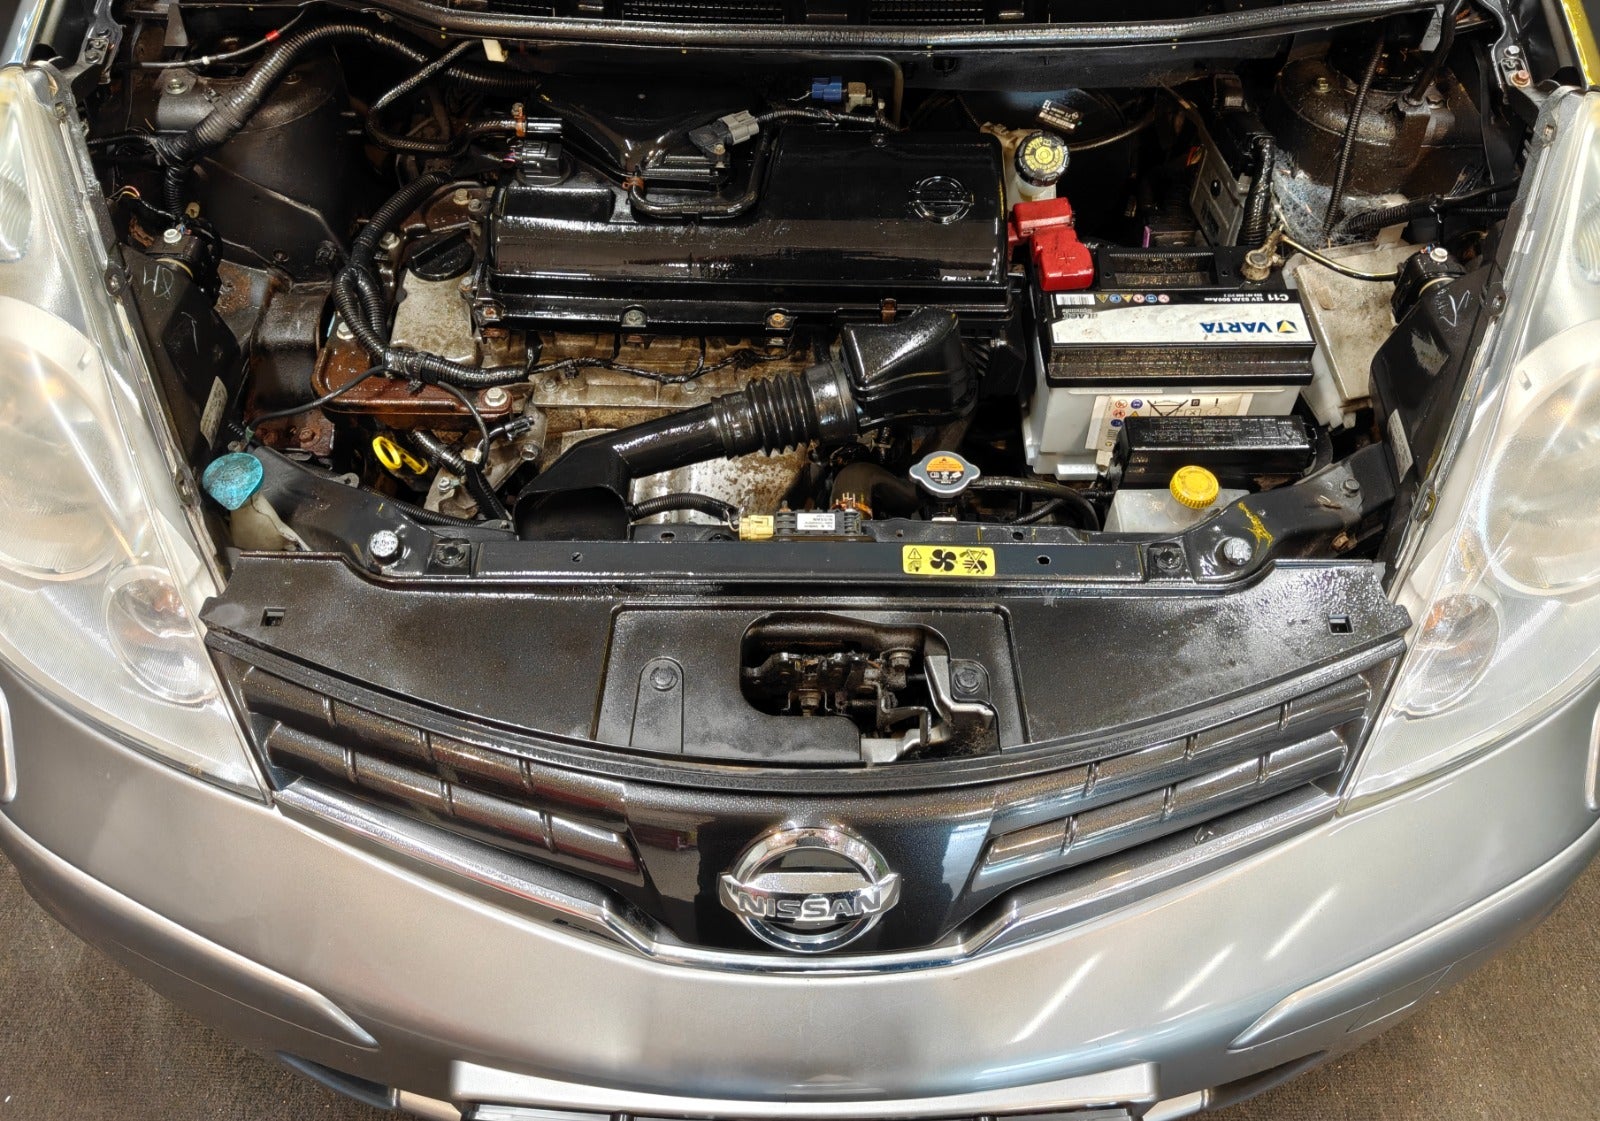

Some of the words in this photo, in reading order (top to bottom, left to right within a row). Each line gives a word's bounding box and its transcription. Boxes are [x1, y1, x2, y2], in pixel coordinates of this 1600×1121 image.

[1267, 293, 1289, 302] C11
[1199, 322, 1273, 333] VARTA
[736, 890, 883, 918] NISSAN
